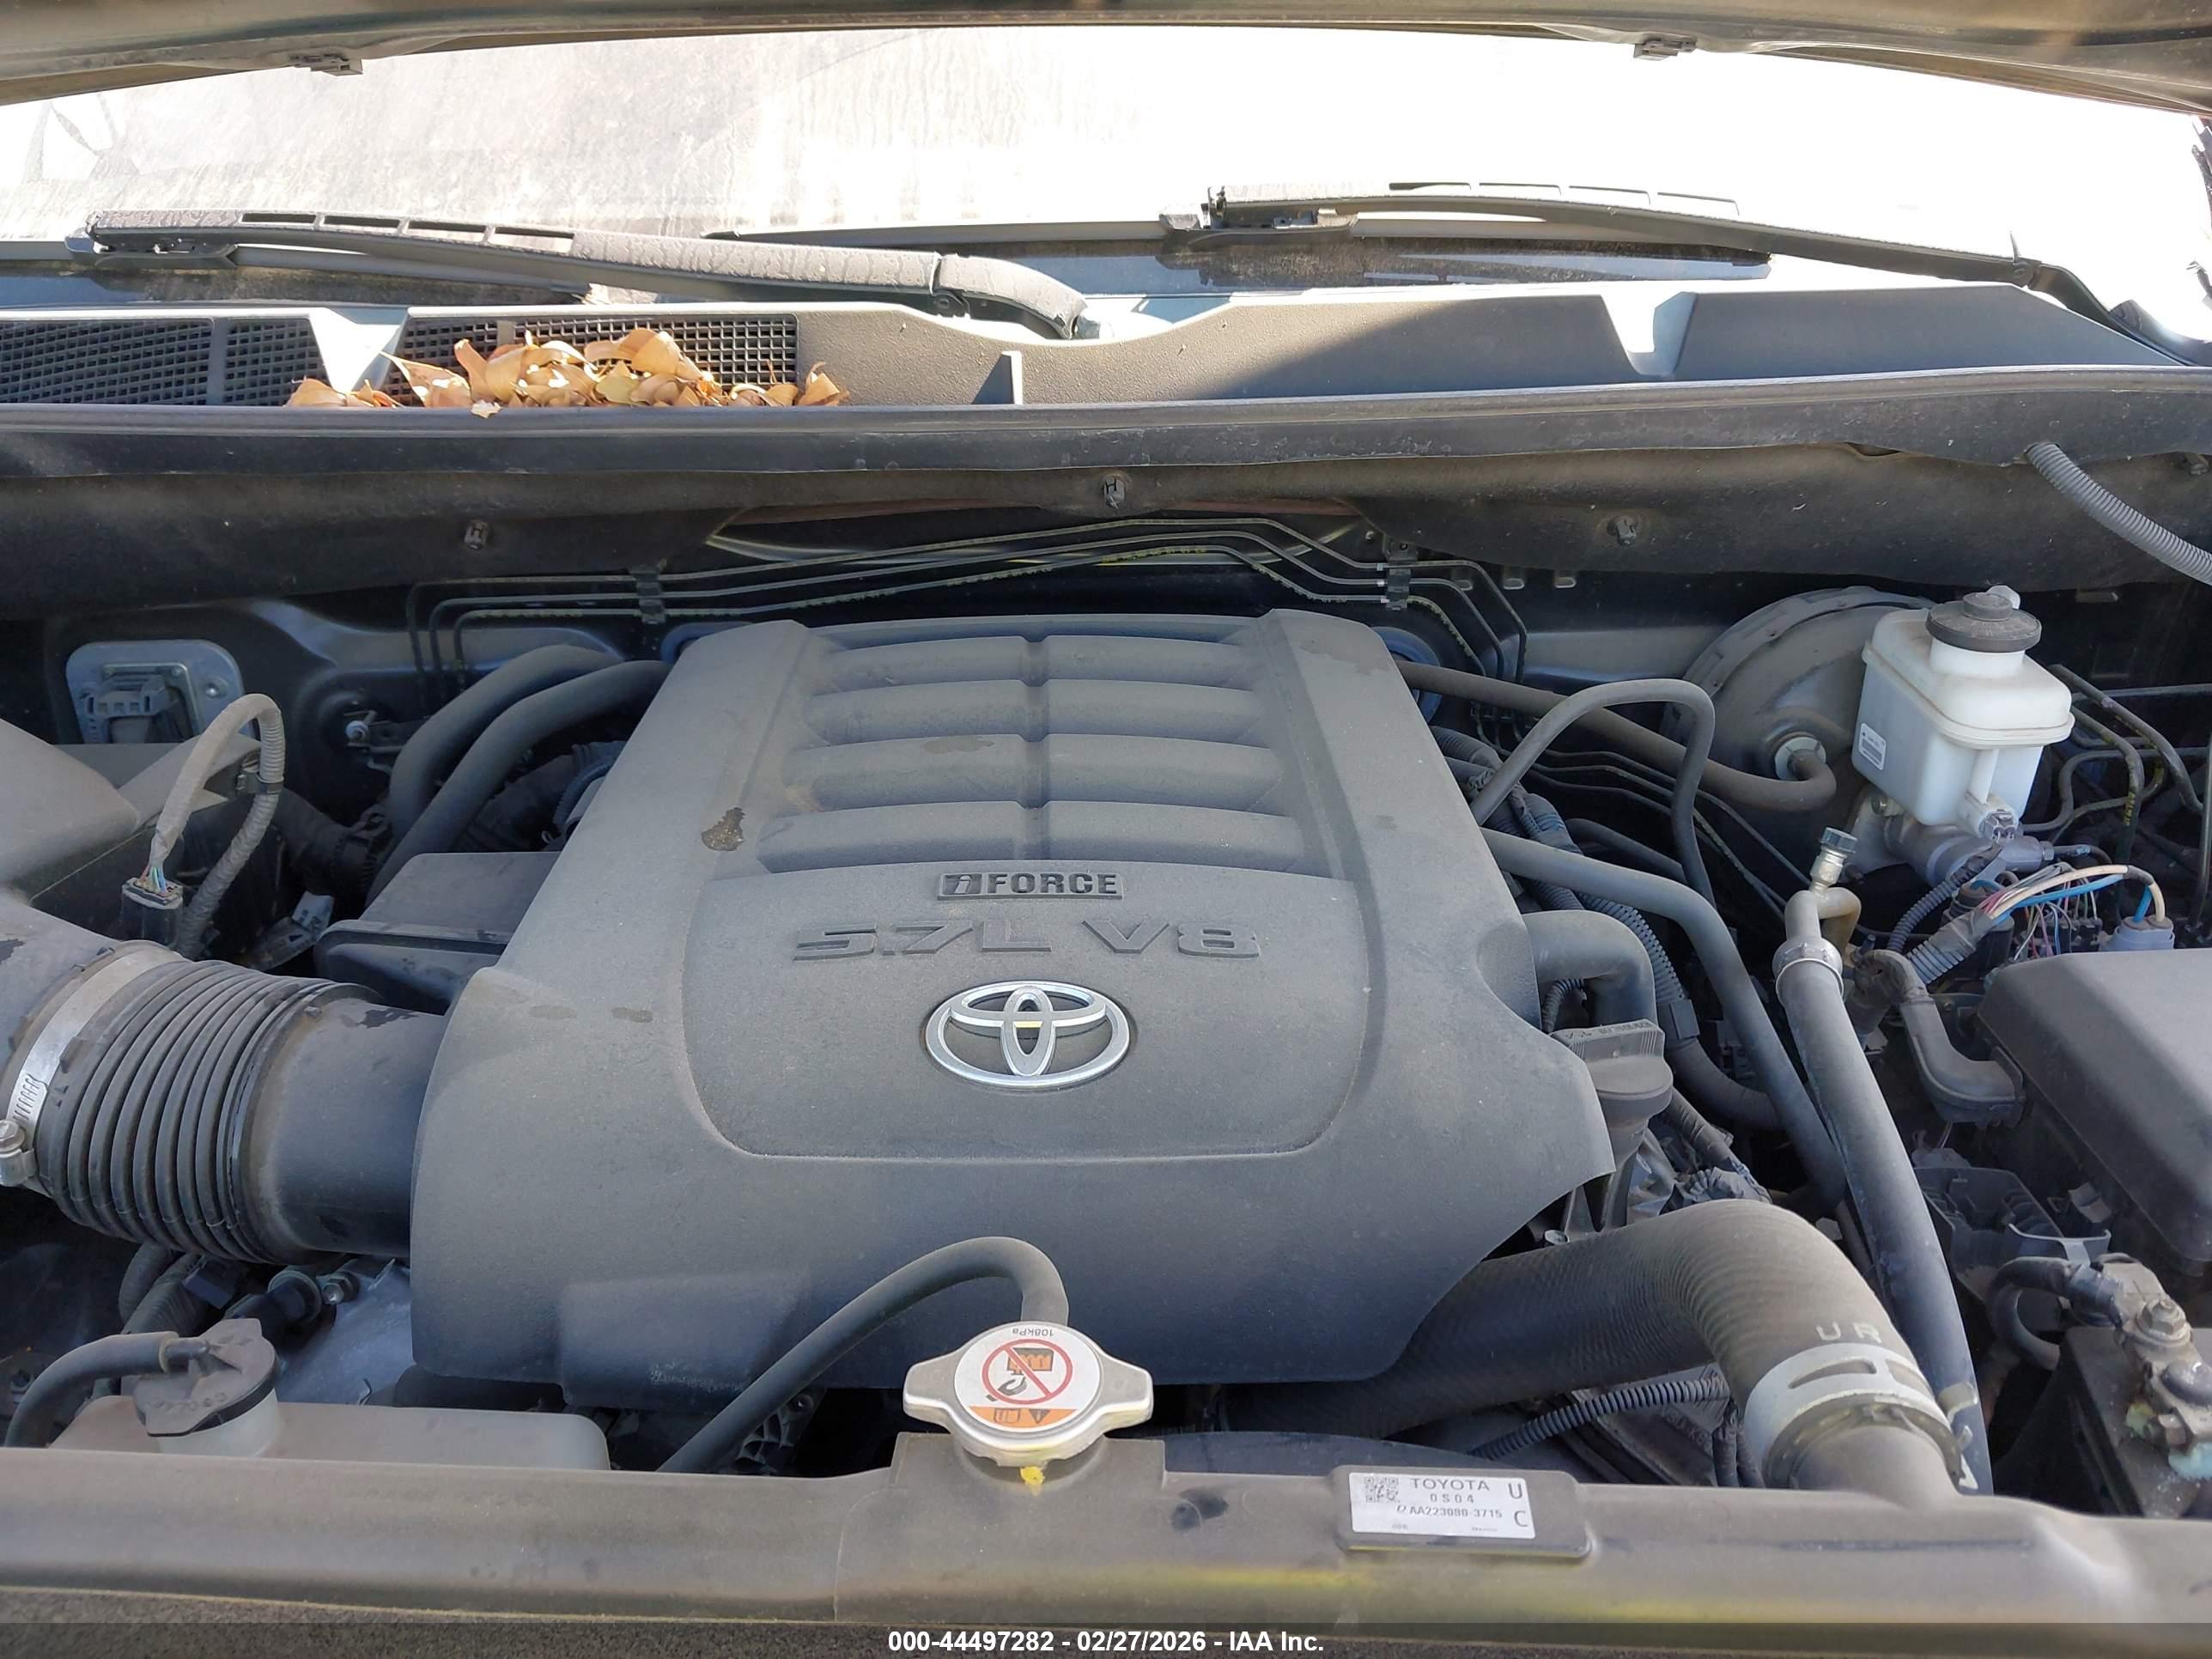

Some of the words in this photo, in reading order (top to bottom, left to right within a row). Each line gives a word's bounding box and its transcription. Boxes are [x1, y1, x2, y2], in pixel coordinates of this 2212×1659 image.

[793, 920, 1051, 961] 5.7L
[1082, 920, 1261, 958] V8
[1411, 1478, 1491, 1492] TOYOTA
[1509, 1483, 1524, 1499] U
[1514, 1510, 1529, 1527] C
